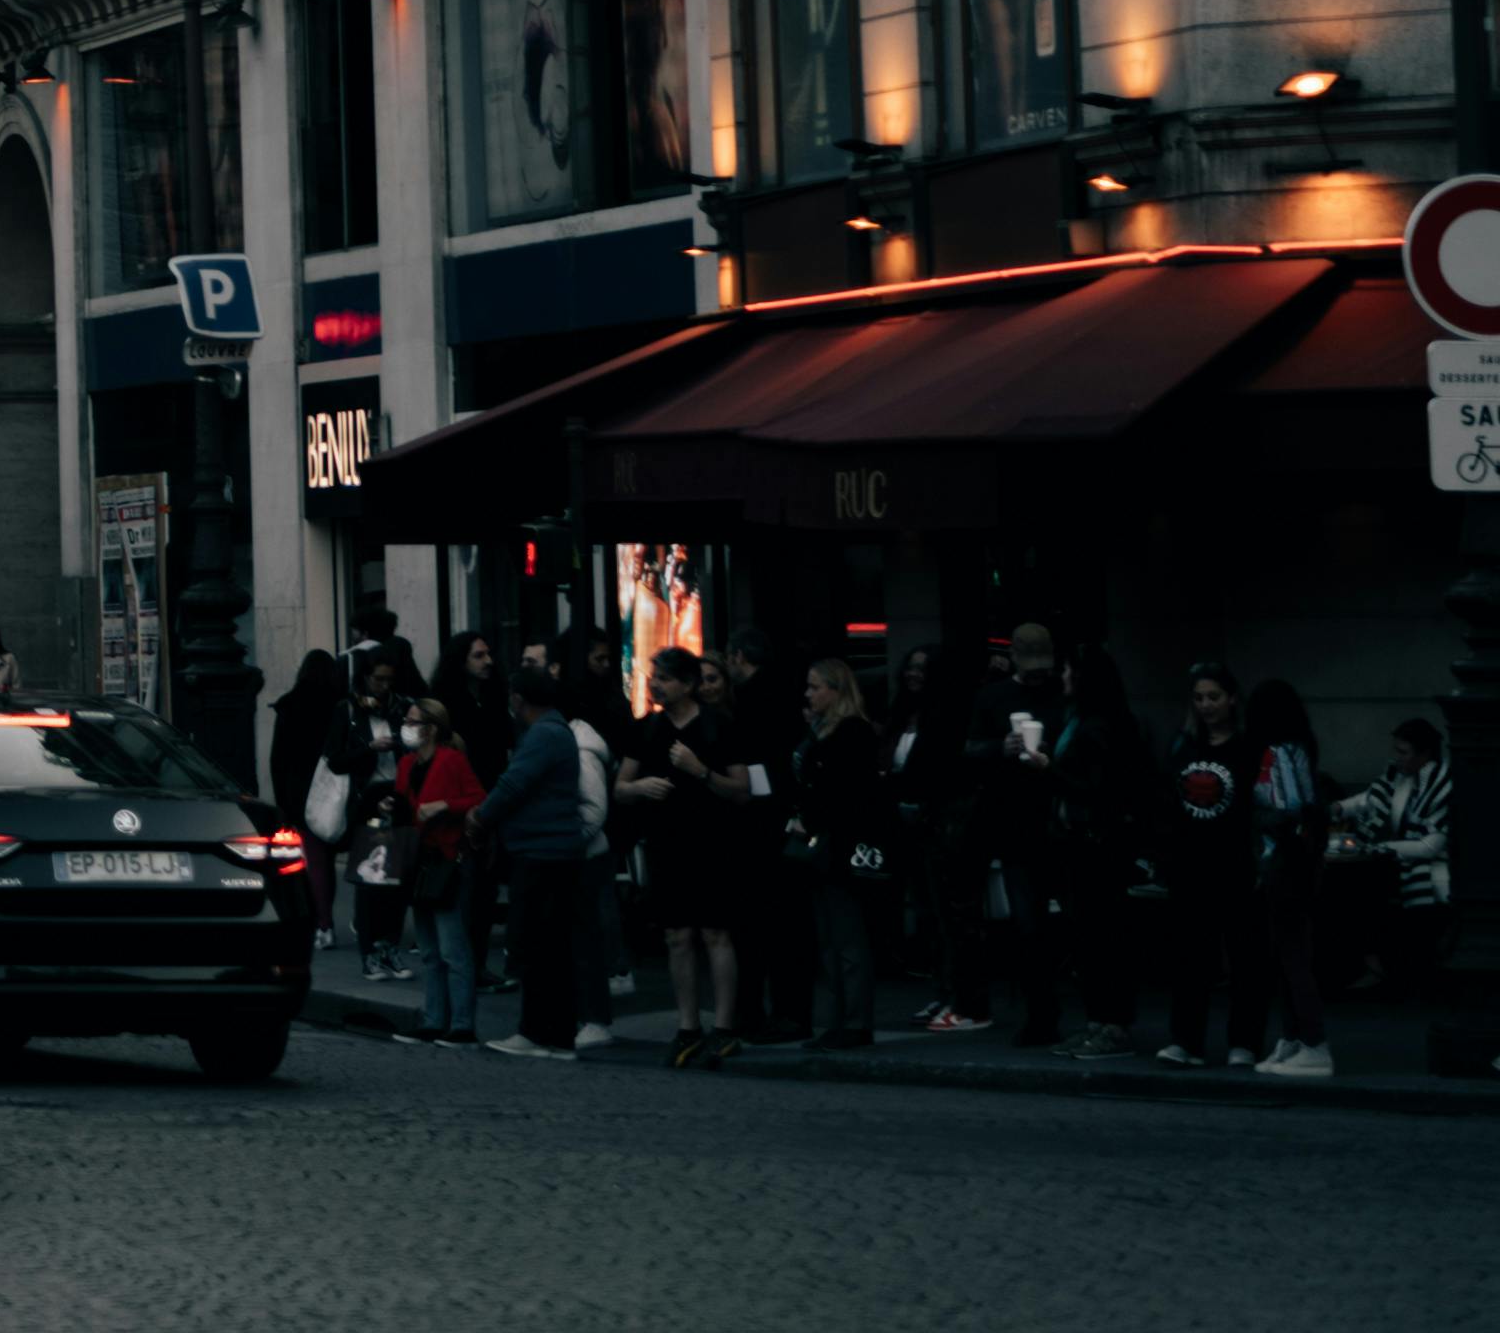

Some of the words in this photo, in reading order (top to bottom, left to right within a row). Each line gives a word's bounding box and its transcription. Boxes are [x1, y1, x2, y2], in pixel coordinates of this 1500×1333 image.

[1007, 106, 1068, 135] CARVEN
[198, 268, 236, 320] P
[189, 341, 246, 360] LOUVRE
[834, 467, 889, 520] RUC
[69, 853, 175, 875] EP-015-LJ
